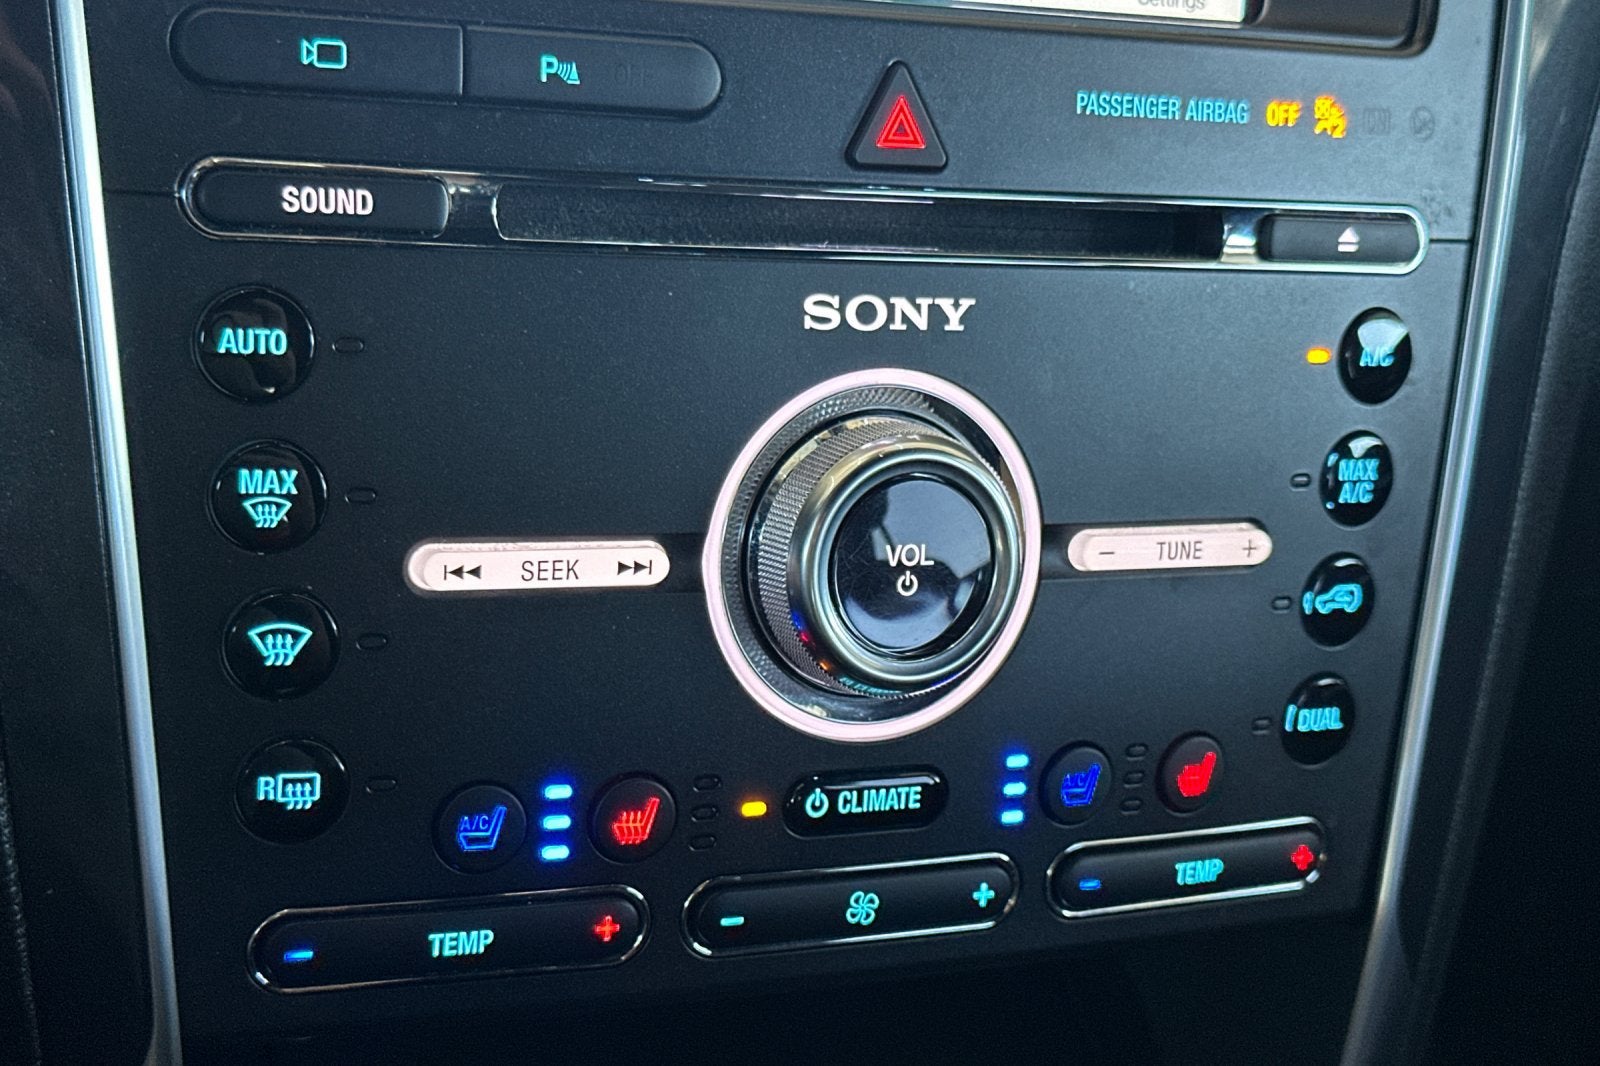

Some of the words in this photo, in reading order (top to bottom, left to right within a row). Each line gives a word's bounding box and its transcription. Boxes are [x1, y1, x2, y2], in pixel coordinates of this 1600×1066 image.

[1076, 89, 1181, 120] PASSENGER
[1185, 98, 1249, 125] AIRBAG
[1265, 101, 1301, 127] OFF
[281, 185, 374, 216] SOUND
[803, 294, 976, 332] SONY
[217, 327, 288, 357] AUTO
[1359, 346, 1396, 367] A/C
[238, 468, 299, 496] MAX
[1338, 458, 1380, 482] MAX
[1337, 480, 1375, 504] A/C
[885, 543, 935, 568] VOL
[1157, 541, 1203, 561] TUNE
[520, 559, 580, 582] SEEK
[1297, 706, 1344, 732] DUAL
[256, 775, 274, 801] R
[837, 786, 922, 815] CLIMATE
[460, 814, 490, 831] A/C
[1174, 857, 1225, 886] TEMP
[428, 928, 495, 958] TEMP
